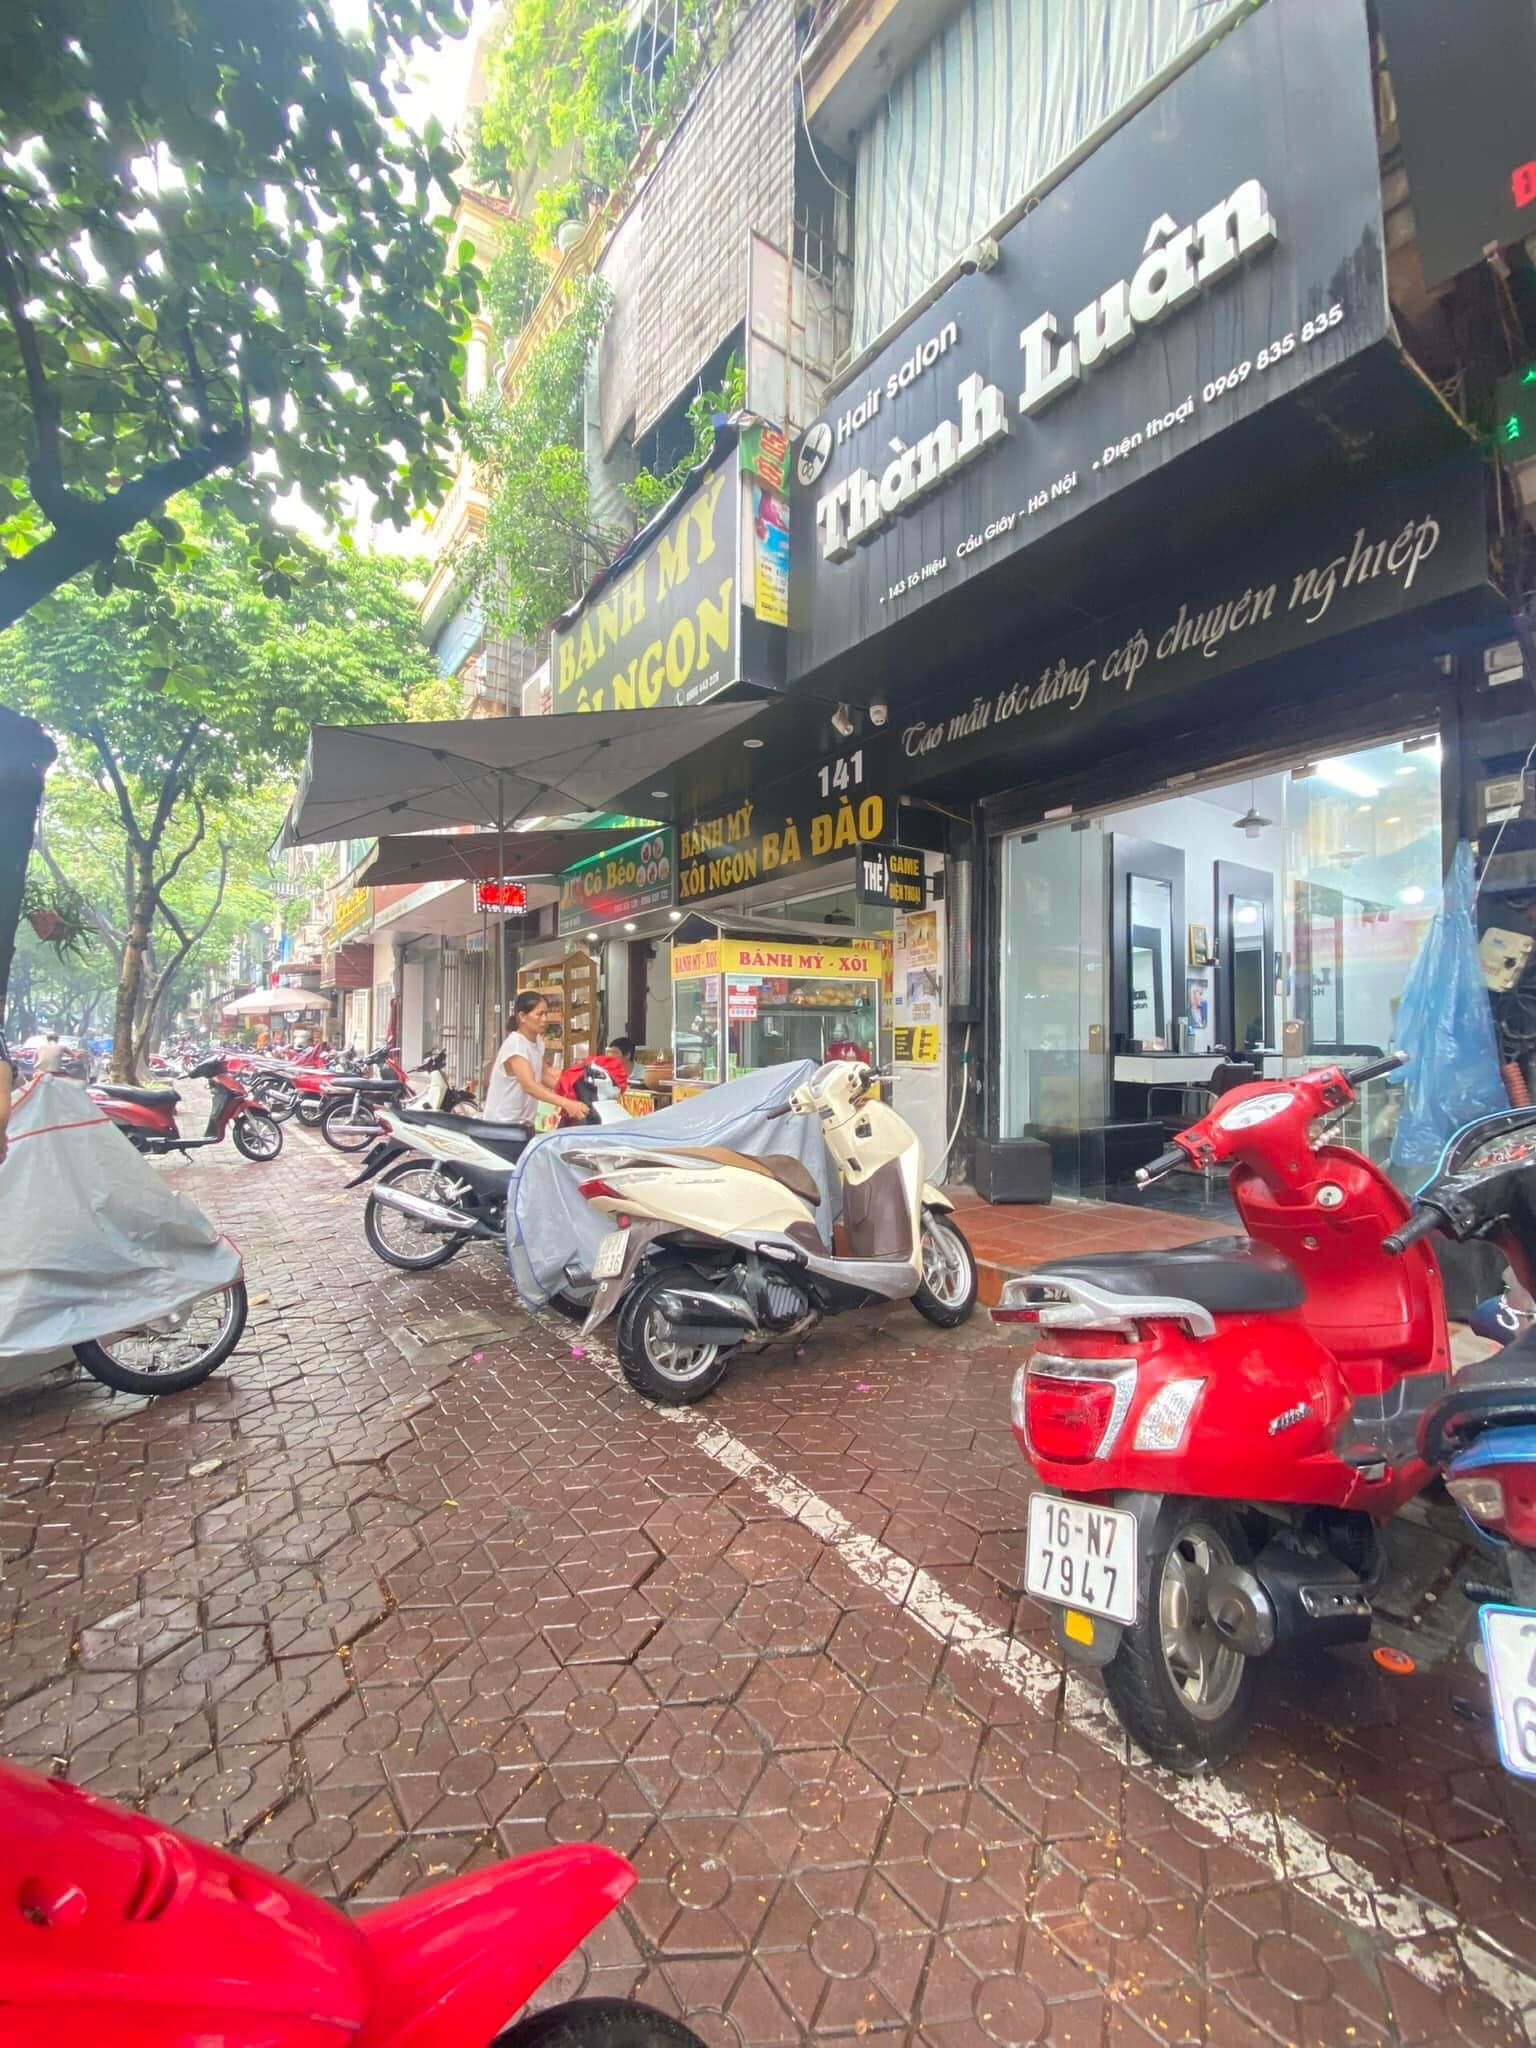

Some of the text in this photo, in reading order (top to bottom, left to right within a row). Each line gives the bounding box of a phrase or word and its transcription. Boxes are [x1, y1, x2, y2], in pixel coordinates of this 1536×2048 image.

[815, 178, 1278, 564] Thành Luân
[837, 320, 957, 444] Hair salon
[888, 580, 906, 600] 143
[1028, 490, 1050, 514] Hà
[1051, 471, 1078, 500] Nội
[1102, 432, 1143, 467] Điện
[1145, 395, 1195, 439] thoại
[1202, 361, 1251, 403] 0969
[1256, 333, 1296, 370] 835
[1301, 304, 1344, 342] 835
[1156, 584, 1278, 659] chuyên
[817, 749, 863, 798] 141
[680, 818, 724, 860] BÁNH
[761, 794, 884, 872] BÀ ĐÀO
[583, 867, 603, 897] Cô
[607, 857, 636, 891] Béo
[680, 847, 758, 898] XÔI NGON
[863, 852, 884, 892] THẺ
[889, 854, 921, 877] GAME
[739, 948, 793, 968] BÁNH
[838, 954, 869, 972] XÔI
[1045, 1503, 1118, 1560] 16-N7
[1041, 1548, 1118, 1610] 7947
